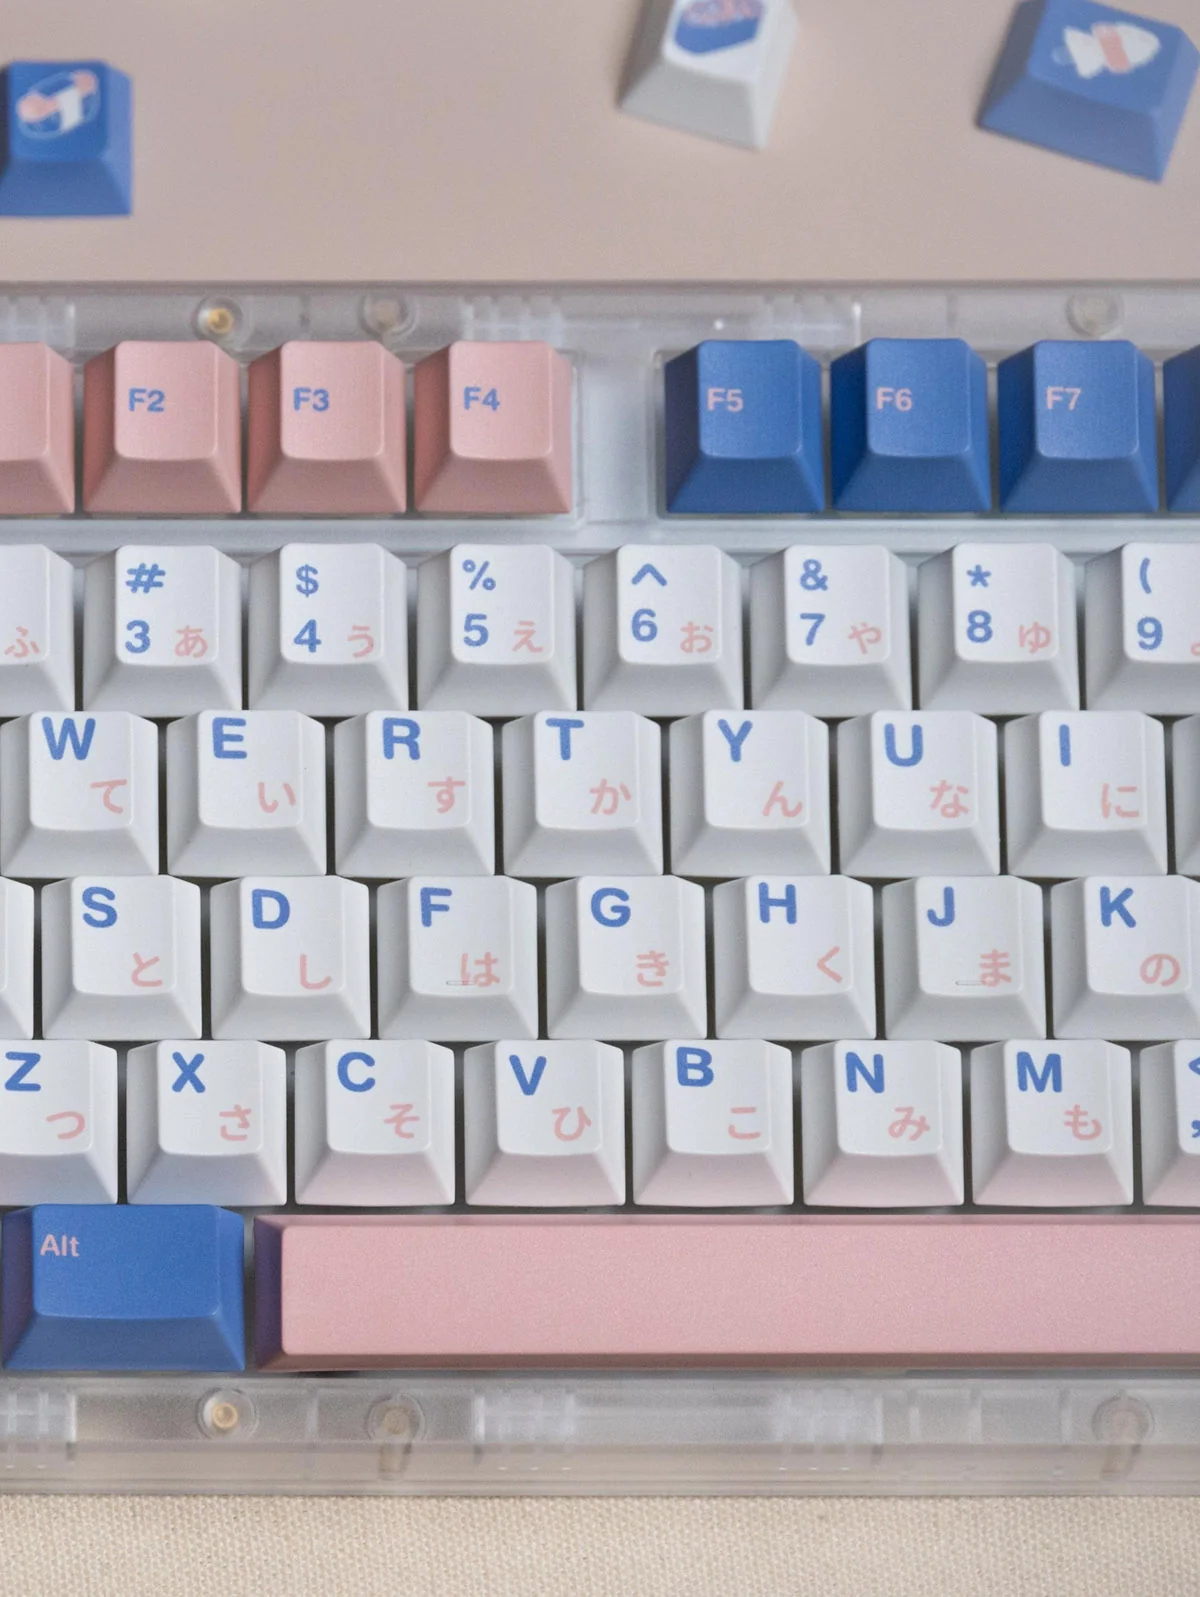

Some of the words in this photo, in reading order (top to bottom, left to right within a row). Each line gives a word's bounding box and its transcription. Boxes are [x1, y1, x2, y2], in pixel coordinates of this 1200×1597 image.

[128, 387, 164, 412] F2
[294, 387, 329, 412] F3
[464, 387, 500, 410] F4
[707, 387, 743, 412] F5
[876, 387, 912, 411] F6
[1046, 386, 1082, 410] F7
[127, 564, 165, 593] #
[297, 565, 319, 595] $
[462, 559, 495, 591] %
[800, 559, 827, 590] &
[1139, 558, 1151, 593] (
[5, 627, 40, 658] ふ
[126, 620, 150, 653] 3
[174, 627, 208, 658] あ
[294, 620, 320, 653] 4
[348, 625, 374, 659] う
[464, 613, 488, 647] 5
[514, 621, 544, 653] え
[632, 609, 658, 642] 6
[680, 621, 713, 653] お
[800, 613, 825, 645] 7
[848, 622, 883, 655] や
[967, 611, 992, 643] 8
[1018, 621, 1051, 653] ゆ
[1137, 617, 1163, 651] 9
[42, 717, 95, 760] W
[212, 717, 247, 759] E
[383, 718, 420, 760] R
[547, 718, 583, 760] T
[719, 720, 751, 762] Y
[884, 724, 923, 767] U
[1059, 724, 1071, 766] I
[90, 779, 127, 813] て
[258, 782, 296, 813] い
[427, 777, 466, 813] す
[590, 779, 631, 815] か
[762, 781, 803, 818] ん
[931, 780, 969, 818] な
[1101, 783, 1140, 818] に
[83, 887, 117, 928] S
[252, 889, 290, 929] D
[420, 887, 451, 927] F
[591, 888, 630, 927] G
[759, 883, 796, 924] H
[928, 887, 954, 927] J
[1100, 887, 1136, 928] K
[131, 953, 163, 988] と
[299, 955, 330, 990] し
[461, 953, 500, 987] は
[637, 950, 668, 987] き
[817, 947, 841, 982] く
[980, 949, 1011, 987] ま
[1140, 954, 1181, 986] の
[5, 1052, 40, 1092] Z
[172, 1052, 204, 1093] X
[337, 1052, 375, 1092] C
[510, 1055, 546, 1096] V
[676, 1047, 714, 1087] B
[846, 1052, 884, 1093] N
[1017, 1052, 1062, 1092] M
[47, 1111, 85, 1139] つ
[220, 1105, 251, 1142] さ
[384, 1103, 419, 1139] そ
[552, 1107, 592, 1141] ひ
[727, 1106, 761, 1140] こ
[888, 1107, 929, 1140] み
[1064, 1104, 1102, 1140] も
[40, 1234, 78, 1257] Alt
